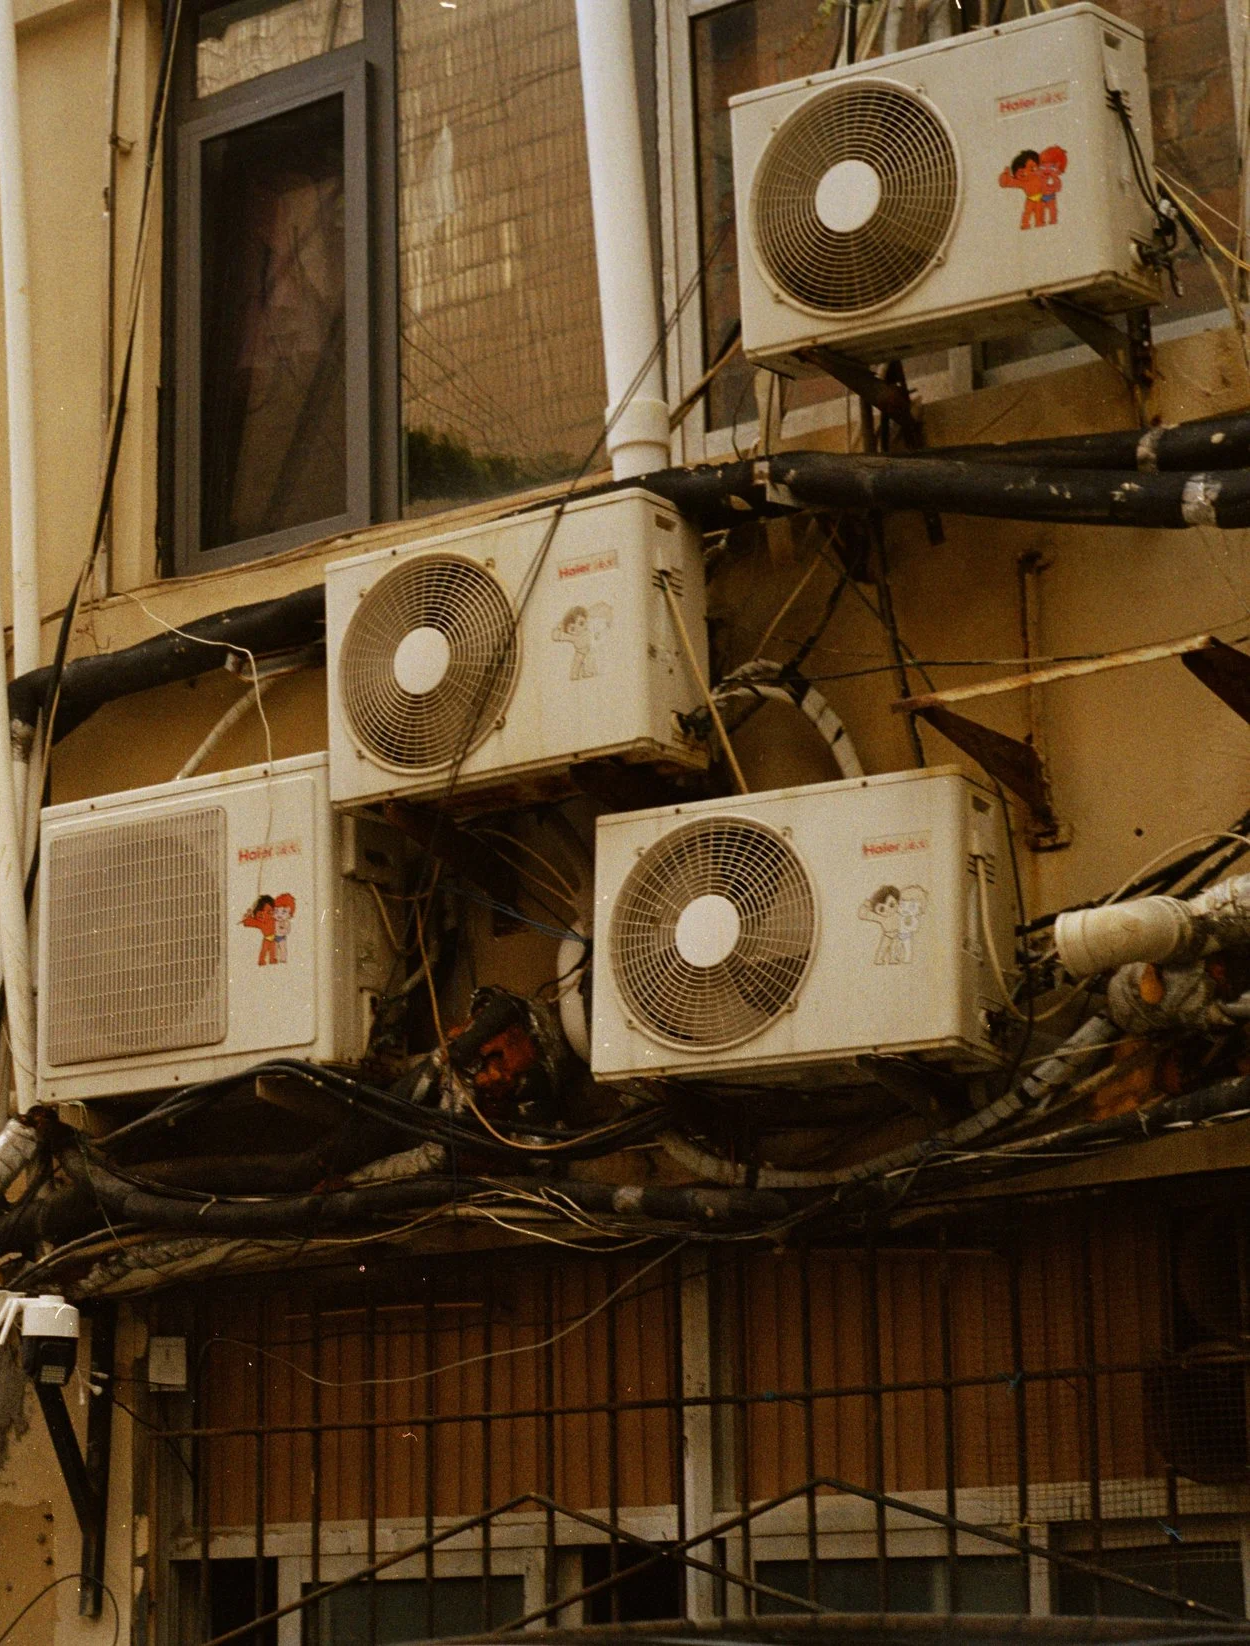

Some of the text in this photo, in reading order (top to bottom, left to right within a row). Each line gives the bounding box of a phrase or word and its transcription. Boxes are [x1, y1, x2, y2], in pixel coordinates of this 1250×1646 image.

[998, 98, 1038, 113] Haier
[558, 564, 590, 578] Haier
[238, 847, 273, 863] Haier
[862, 843, 900, 856] Haier
